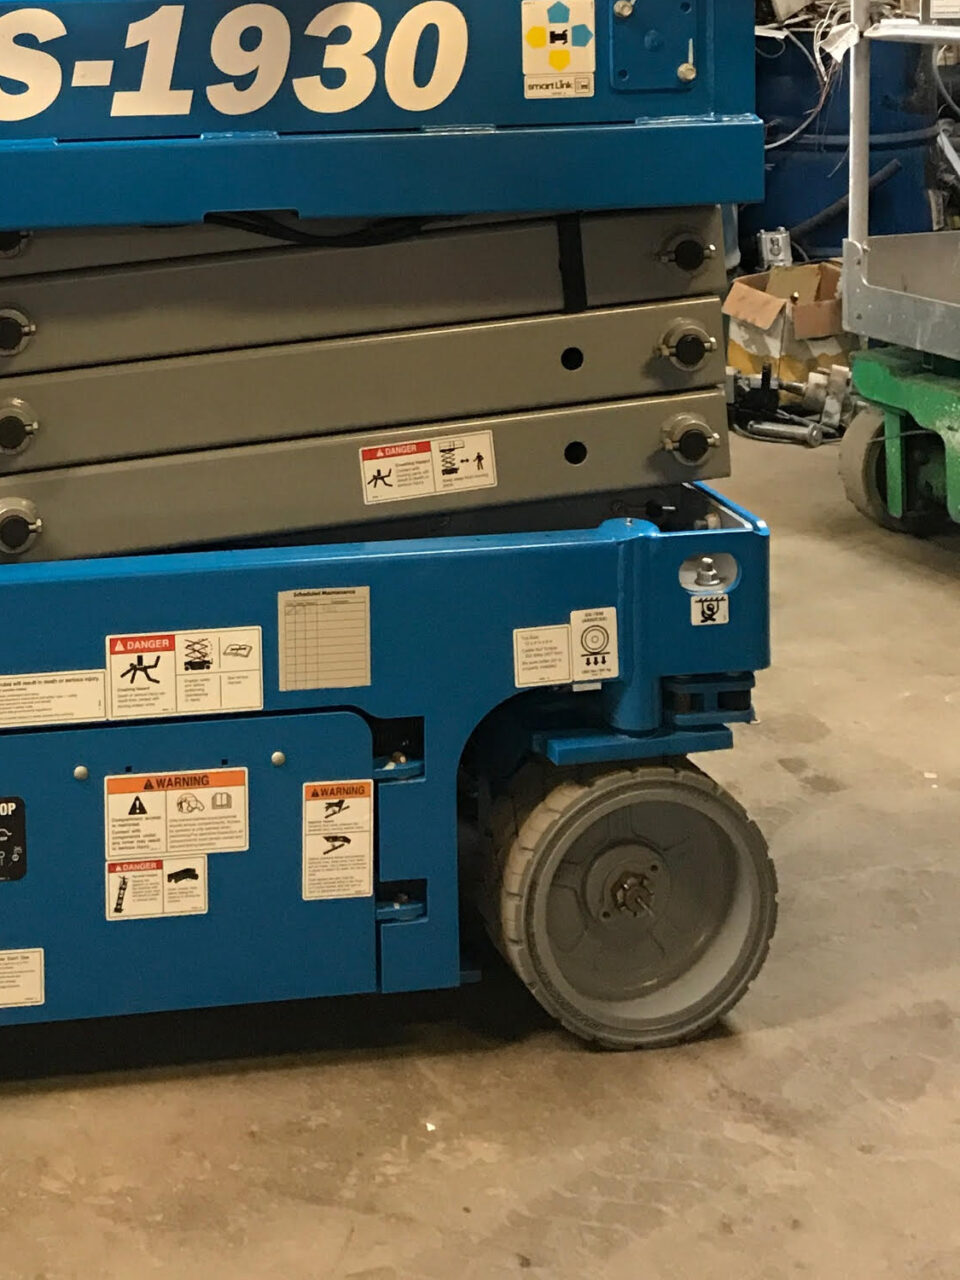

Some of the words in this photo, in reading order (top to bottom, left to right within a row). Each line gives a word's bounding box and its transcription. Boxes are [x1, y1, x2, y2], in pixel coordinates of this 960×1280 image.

[385, 444, 417, 456] DANGER
[127, 639, 170, 650] DANGER
[156, 775, 210, 788] WARNING
[320, 785, 365, 797] WARNING
[122, 862, 157, 871] DANGER
